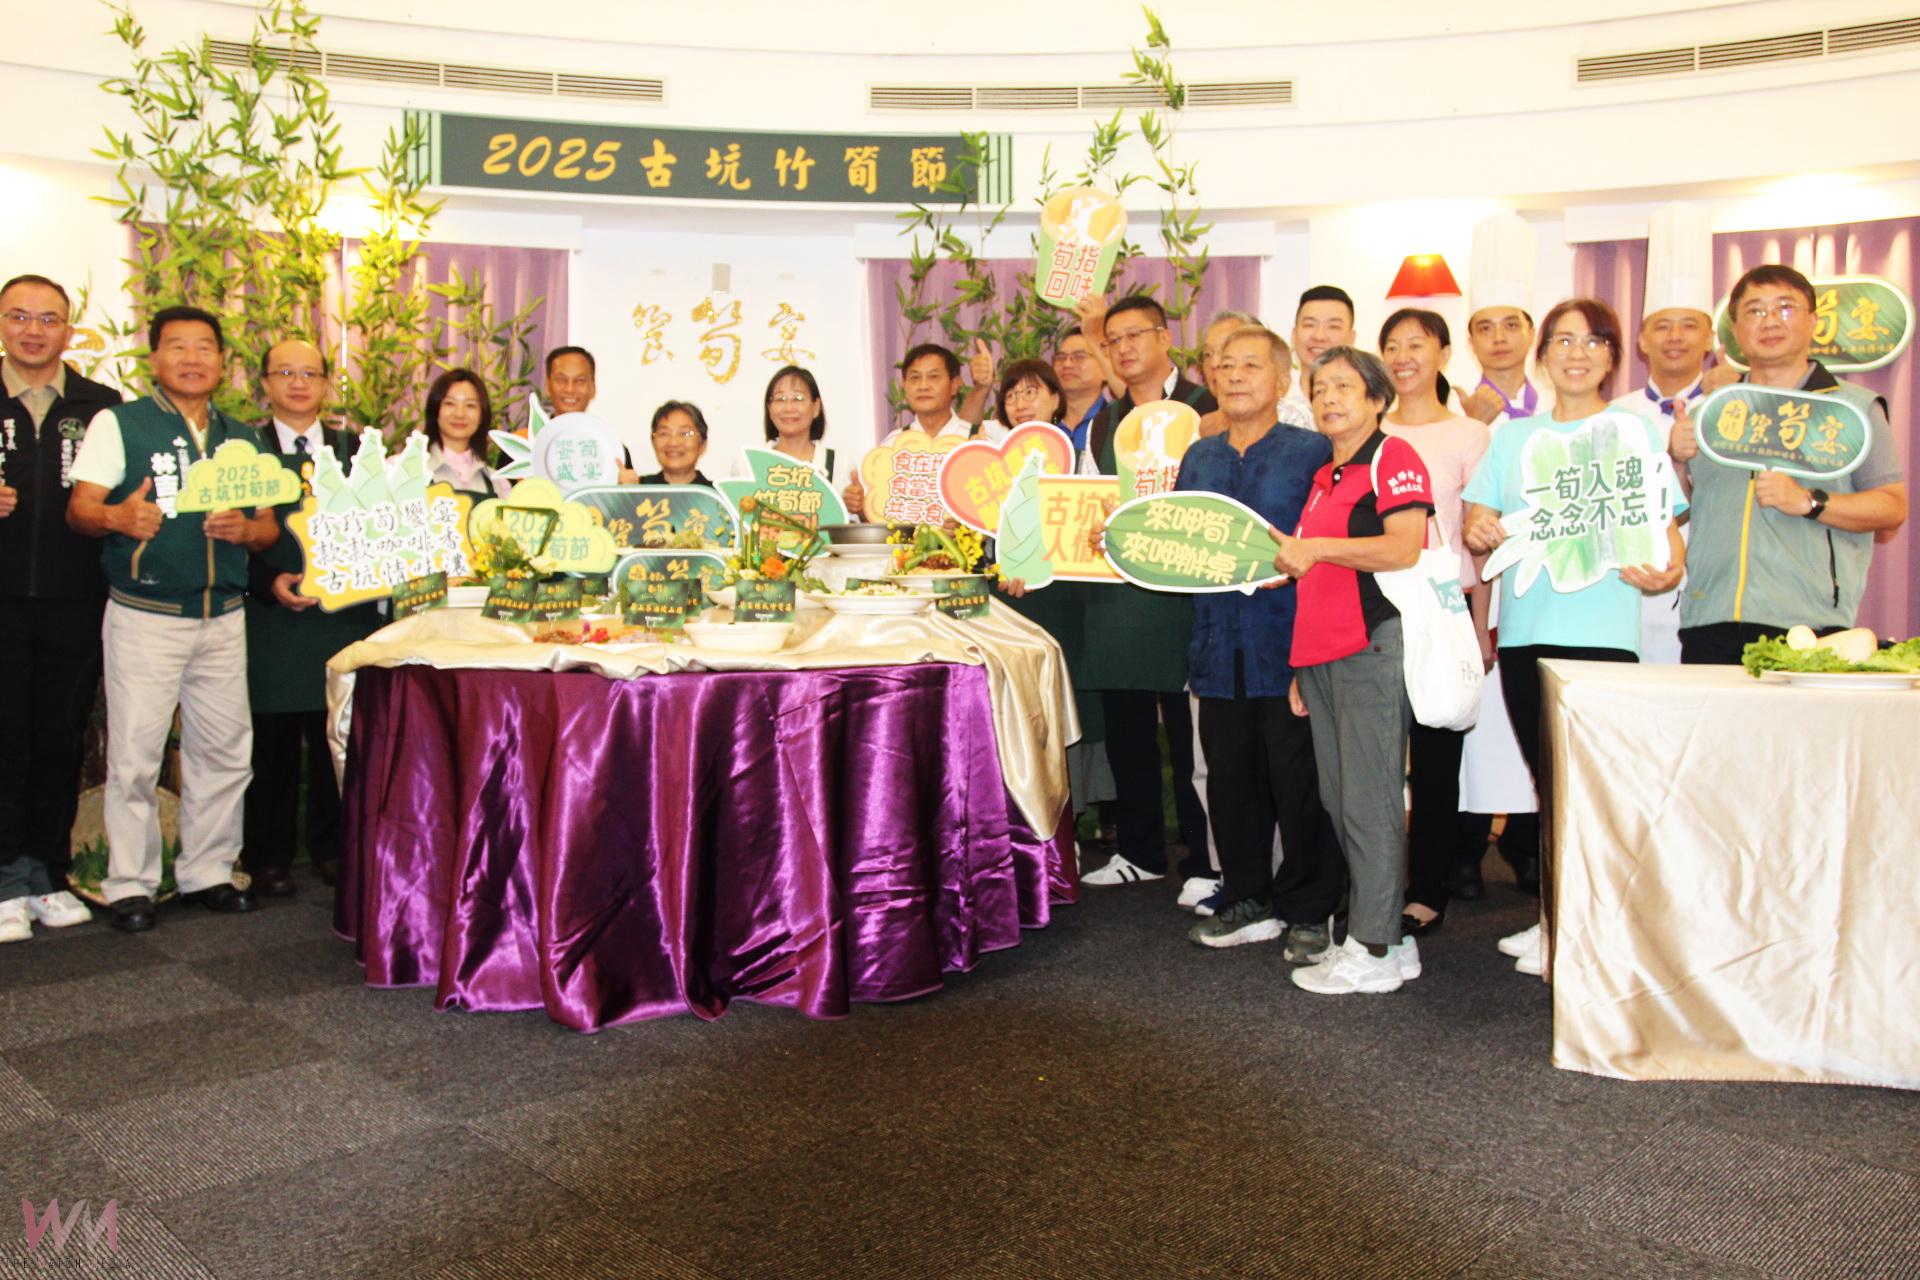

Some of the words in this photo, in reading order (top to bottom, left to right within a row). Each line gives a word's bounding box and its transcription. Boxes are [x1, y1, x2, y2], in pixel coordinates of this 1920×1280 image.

[482, 131, 622, 181] 2025
[217, 465, 260, 483] 2025
[767, 463, 814, 488] 古坑
[199, 479, 280, 504] 古坑竹筍節
